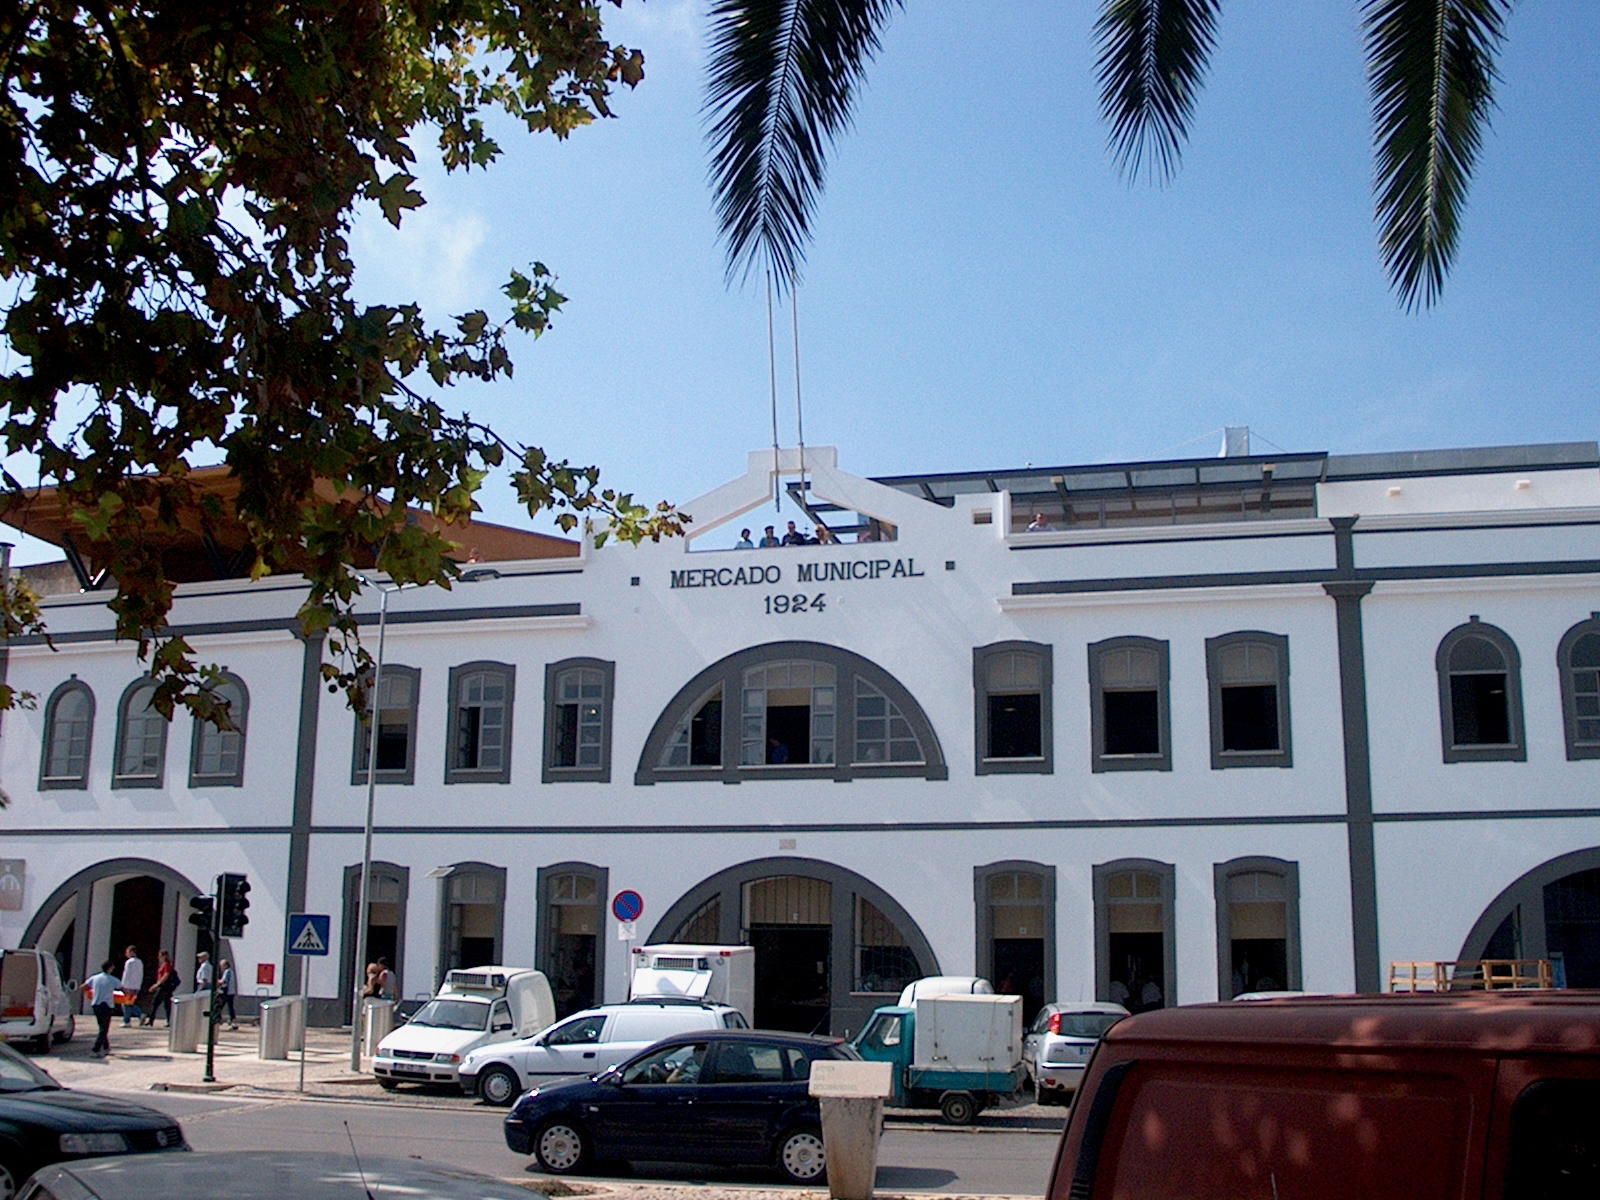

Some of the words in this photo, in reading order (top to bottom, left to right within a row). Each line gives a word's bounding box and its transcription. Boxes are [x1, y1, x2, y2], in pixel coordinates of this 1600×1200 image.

[670, 565, 781, 588] MERCADO
[797, 558, 925, 582] MUNICIPAL
[764, 593, 826, 614] 1924
